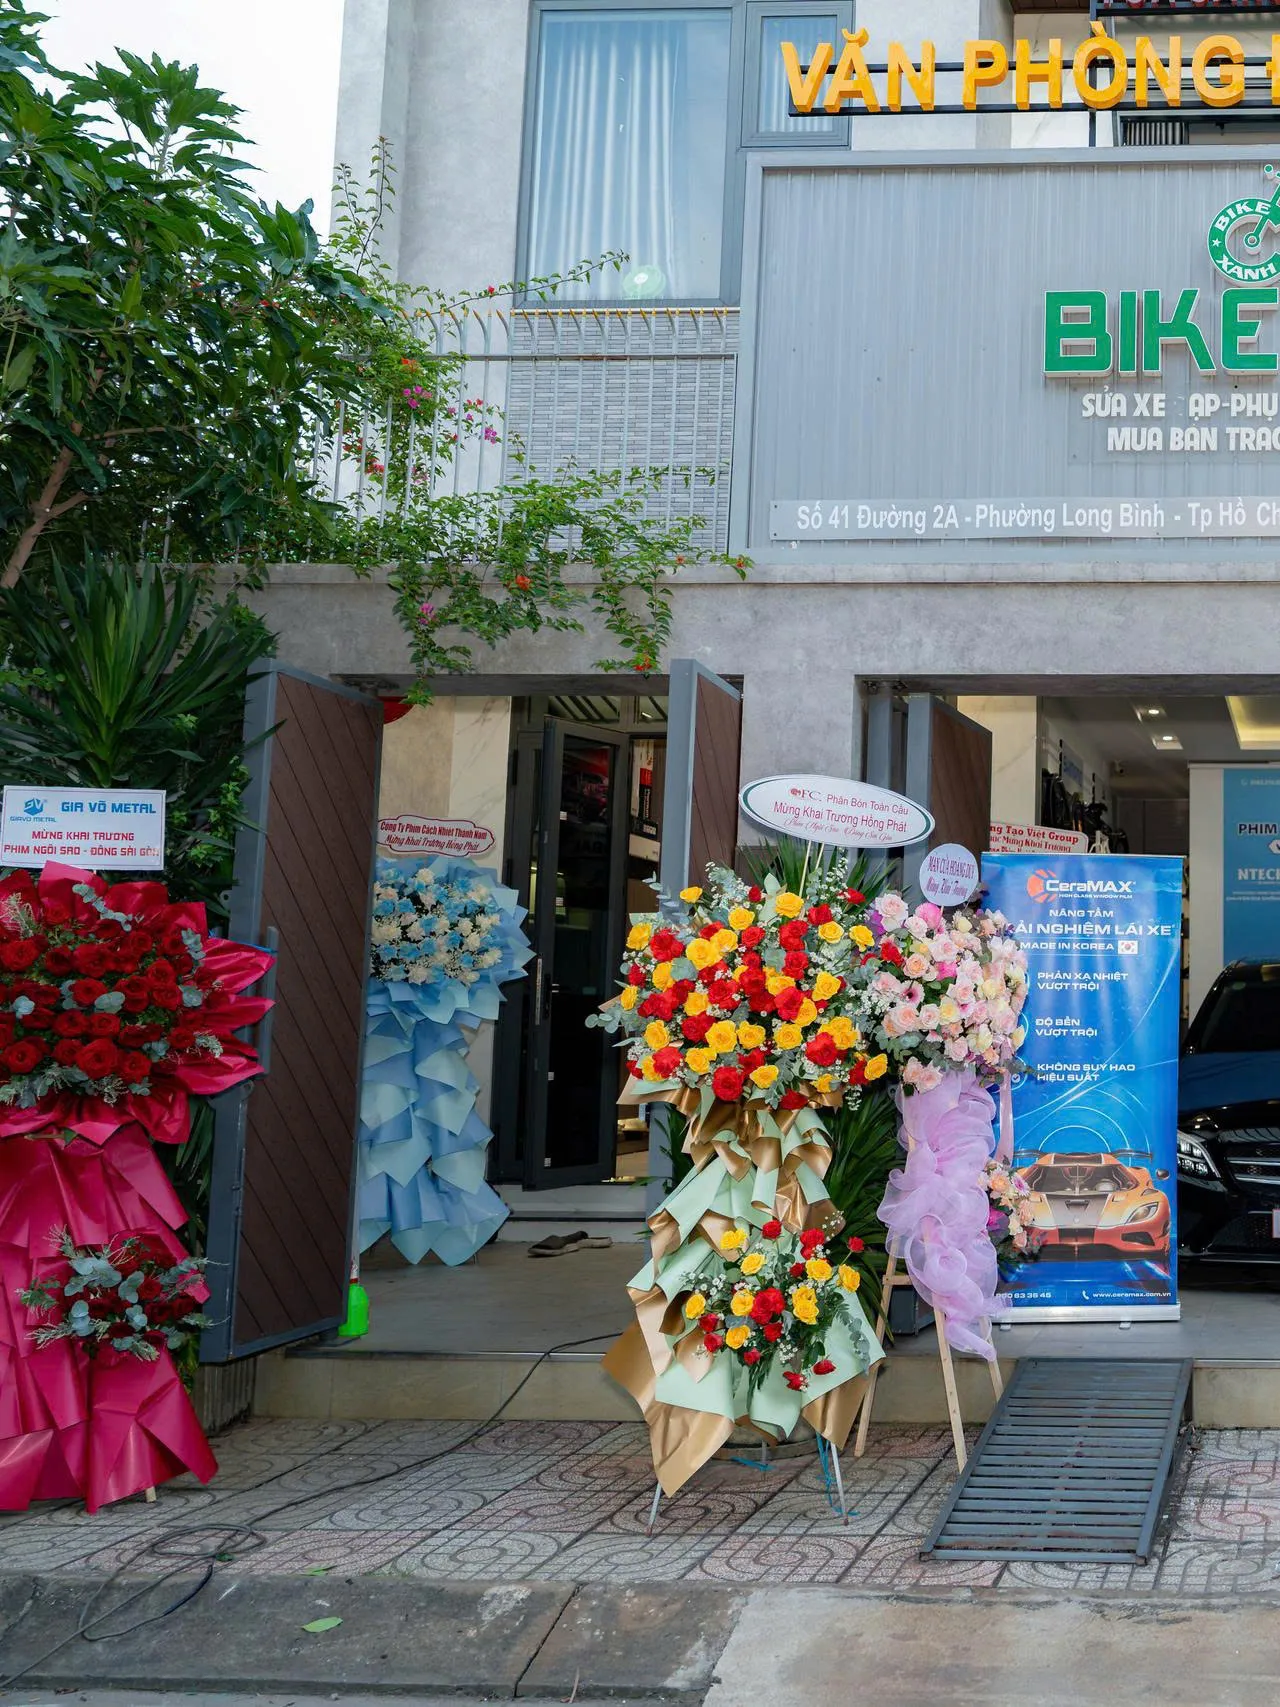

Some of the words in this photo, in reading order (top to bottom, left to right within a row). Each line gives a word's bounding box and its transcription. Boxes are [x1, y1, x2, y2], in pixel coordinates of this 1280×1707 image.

[780, 28, 936, 113] VĂN
[961, 20, 1245, 111] PHÒNG
[1214, 200, 1272, 232] BIKE
[1216, 255, 1276, 280] XANH
[1042, 287, 1279, 376] BIKE
[1082, 385, 1127, 417] SỬA
[1132, 393, 1166, 417] XE
[1108, 427, 1163, 451] MUA
[797, 501, 822, 530] Số
[828, 505, 849, 528] 41
[857, 504, 926, 534] Đường
[933, 505, 959, 529] 2A
[976, 503, 1055, 533] Phường
[1062, 503, 1113, 533] Long
[1119, 502, 1165, 528] Bình
[1188, 502, 1212, 532] Tp
[1219, 496, 1247, 527] Hồ
[61, 801, 84, 812] GIA
[89, 800, 107, 812] VÕ
[111, 802, 156, 813] METAL
[774, 801, 800, 819] Mừng
[803, 806, 823, 819] Khai
[826, 809, 859, 827] Trương
[32, 828, 63, 840] MỪNG
[66, 831, 89, 840] KHAI
[93, 831, 134, 841] TRƯƠNG
[1238, 823, 1277, 835] PHIM
[1049, 831, 1079, 844] Group
[4, 844, 30, 854] PHIM
[34, 843, 57, 855] NGÔI
[60, 846, 81, 855] SAO
[90, 844, 117, 856] ĐÔNG
[120, 845, 136, 856] SÀI
[1046, 880, 1132, 892] CeraMAX
[1049, 908, 1085, 917] NÂNG
[1087, 906, 1114, 918] TẦM
[1037, 921, 1110, 937] NGHIỆM
[1115, 922, 1142, 935] LÁI
[1147, 925, 1171, 936] XE
[1020, 942, 1056, 950] MADE
[1059, 942, 1070, 950] IN
[1072, 942, 1114, 950] KOREA
[1038, 970, 1072, 980] PHẢN
[1074, 972, 1091, 982] XẠ
[1093, 971, 1128, 982] NHIỆT
[1037, 982, 1070, 991] VƯỢT
[1072, 981, 1099, 992] TRỘI
[1035, 1016, 1053, 1027] ĐỘ
[1055, 1016, 1080, 1026] BỀN
[1035, 1028, 1068, 1038] VƯỢT
[1070, 1027, 1098, 1038] TRỘI
[1037, 1062, 1080, 1071] KHÔNG
[1083, 1063, 1106, 1071] SUY
[1110, 1063, 1135, 1071] HAO
[1037, 1072, 1065, 1082] HIỆU
[1067, 1071, 1099, 1081] SUẤT
